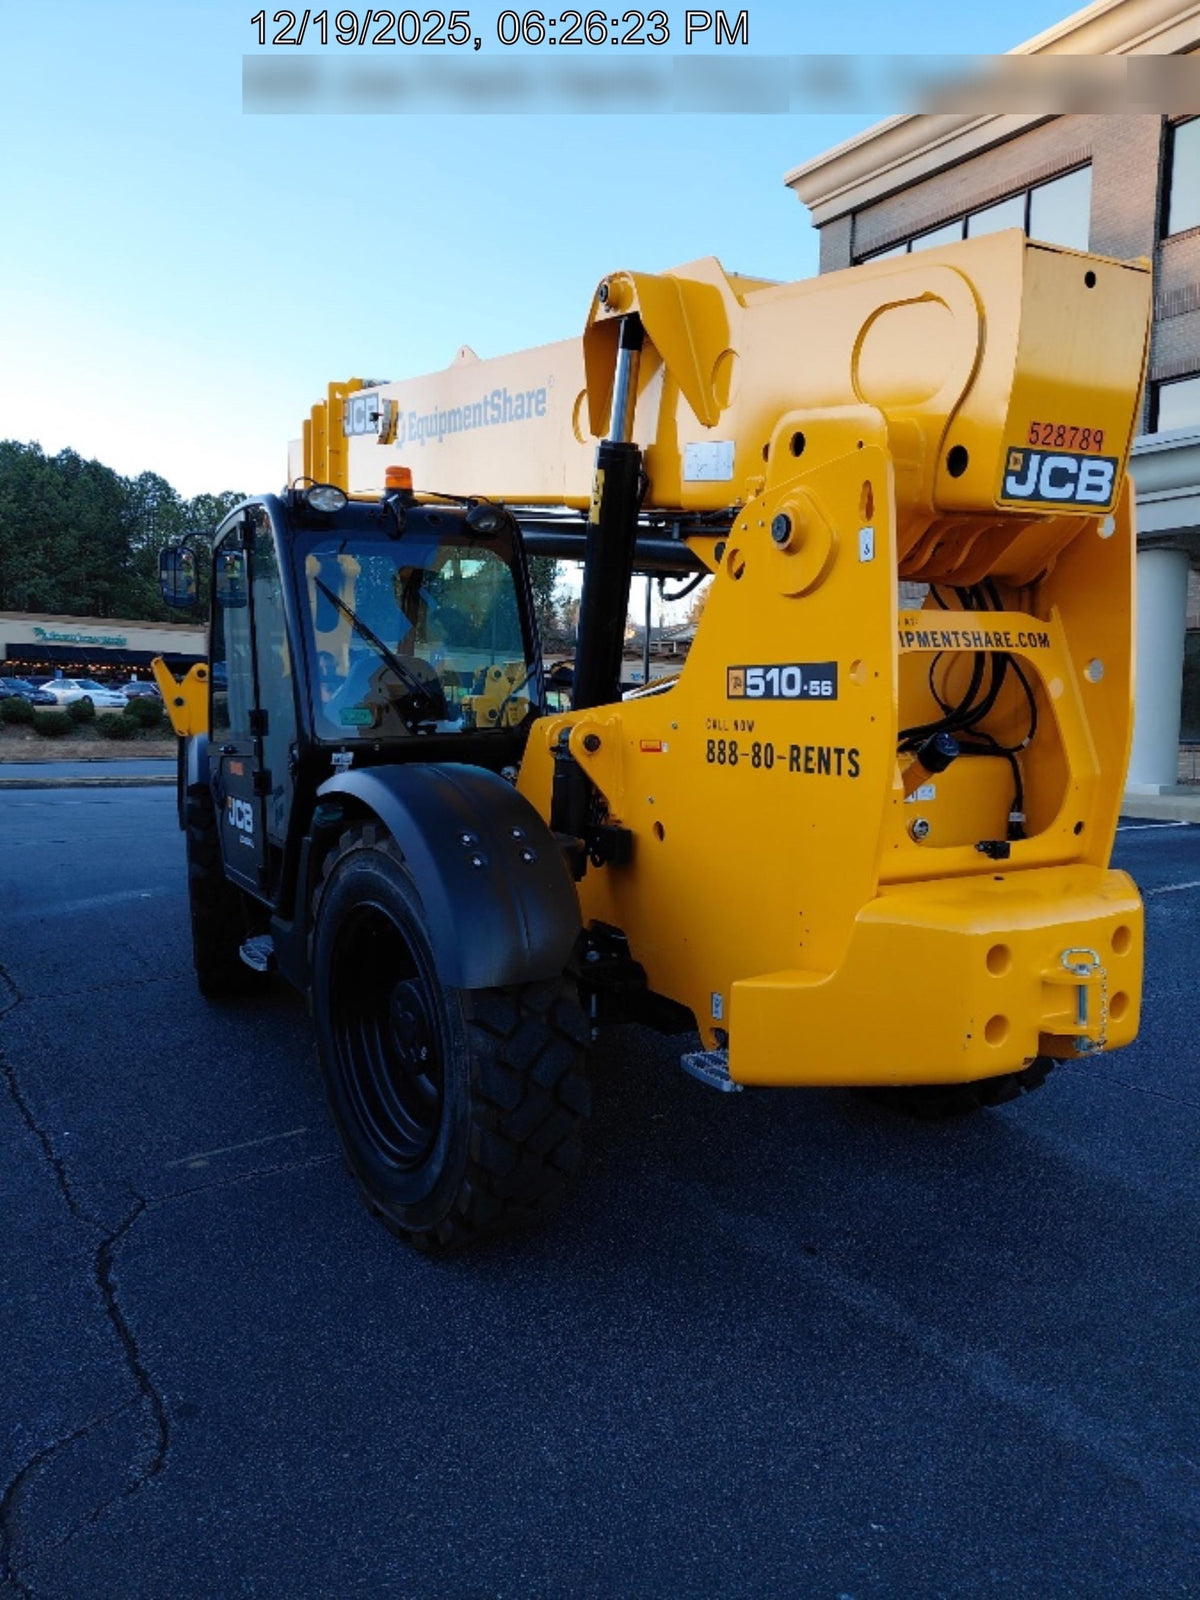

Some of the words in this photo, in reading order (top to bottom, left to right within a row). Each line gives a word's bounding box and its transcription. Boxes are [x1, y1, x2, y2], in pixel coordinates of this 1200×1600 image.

[407, 387, 547, 447] EquipmentShare
[1028, 421, 1105, 452] 528789
[1005, 453, 1115, 502] JCB
[733, 719, 755, 733] NOW
[706, 738, 861, 779] 888-80-RENTS
[228, 797, 254, 834] JCB
